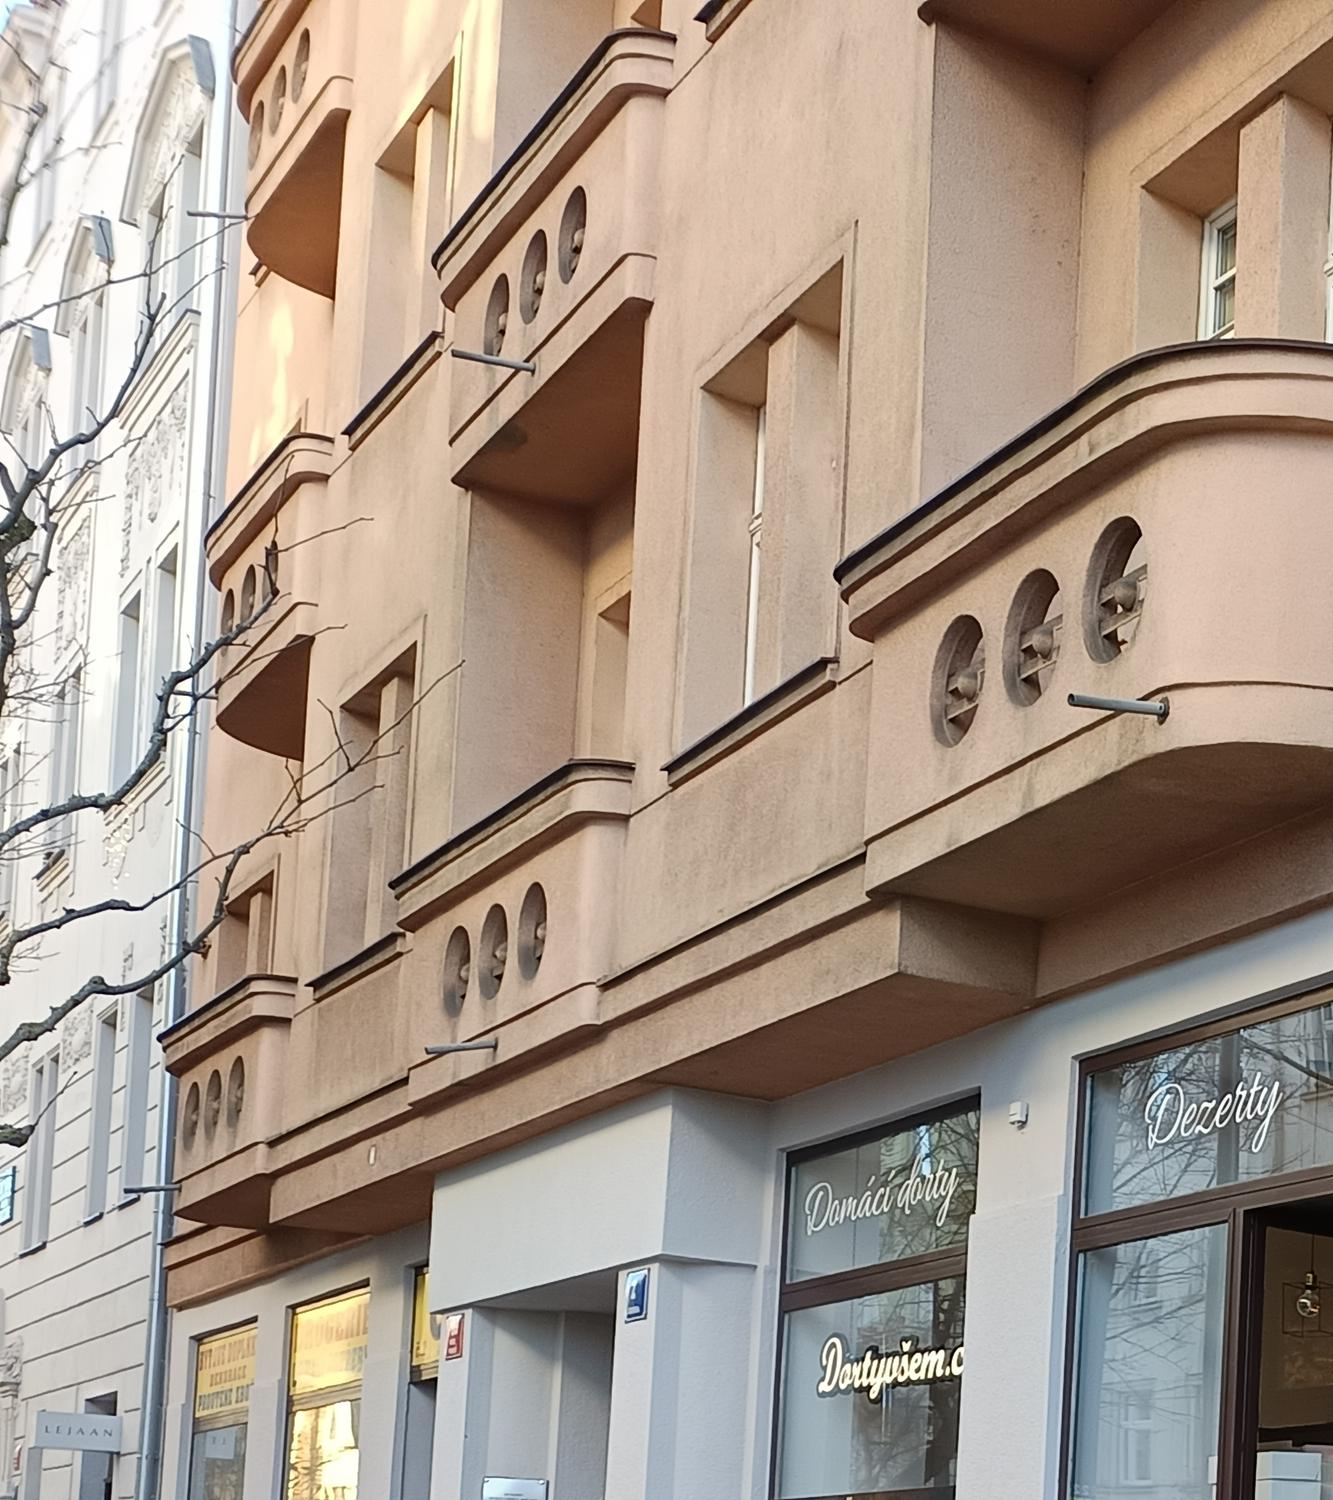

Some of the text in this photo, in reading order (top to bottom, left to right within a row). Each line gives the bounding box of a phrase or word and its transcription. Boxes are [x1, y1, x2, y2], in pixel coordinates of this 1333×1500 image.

[1145, 1071, 1283, 1153] Dezerty
[805, 1153, 960, 1236] Domácí dorty
[818, 1337, 964, 1400] Dortyvšem.c
[44, 1425, 113, 1437] LEJAAN
